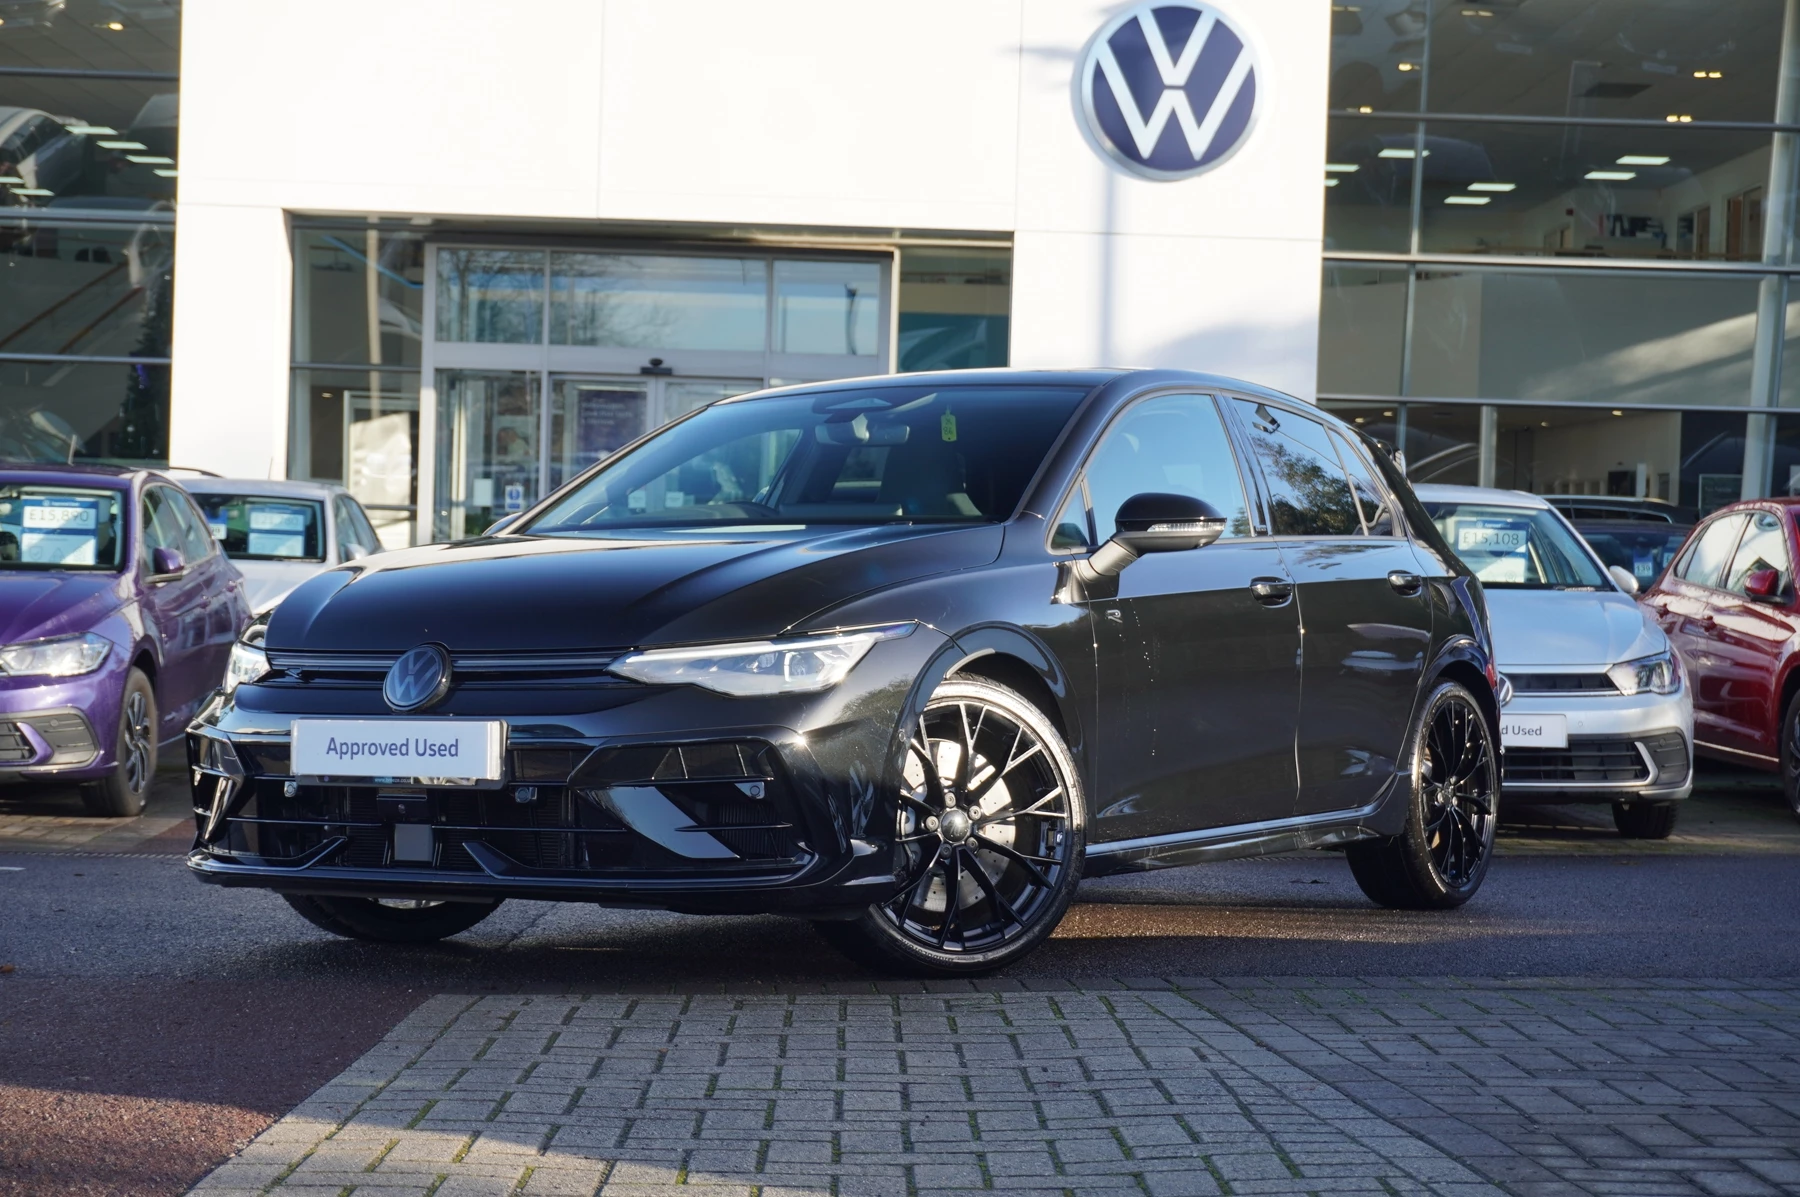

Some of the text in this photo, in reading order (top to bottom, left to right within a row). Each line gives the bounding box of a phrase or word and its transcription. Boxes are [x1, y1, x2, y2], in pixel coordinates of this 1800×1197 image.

[1090, 4, 1257, 162] VW
[1463, 532, 1519, 546] £15,108
[1512, 725, 1542, 736] Used
[326, 737, 458, 760] Approved Used
